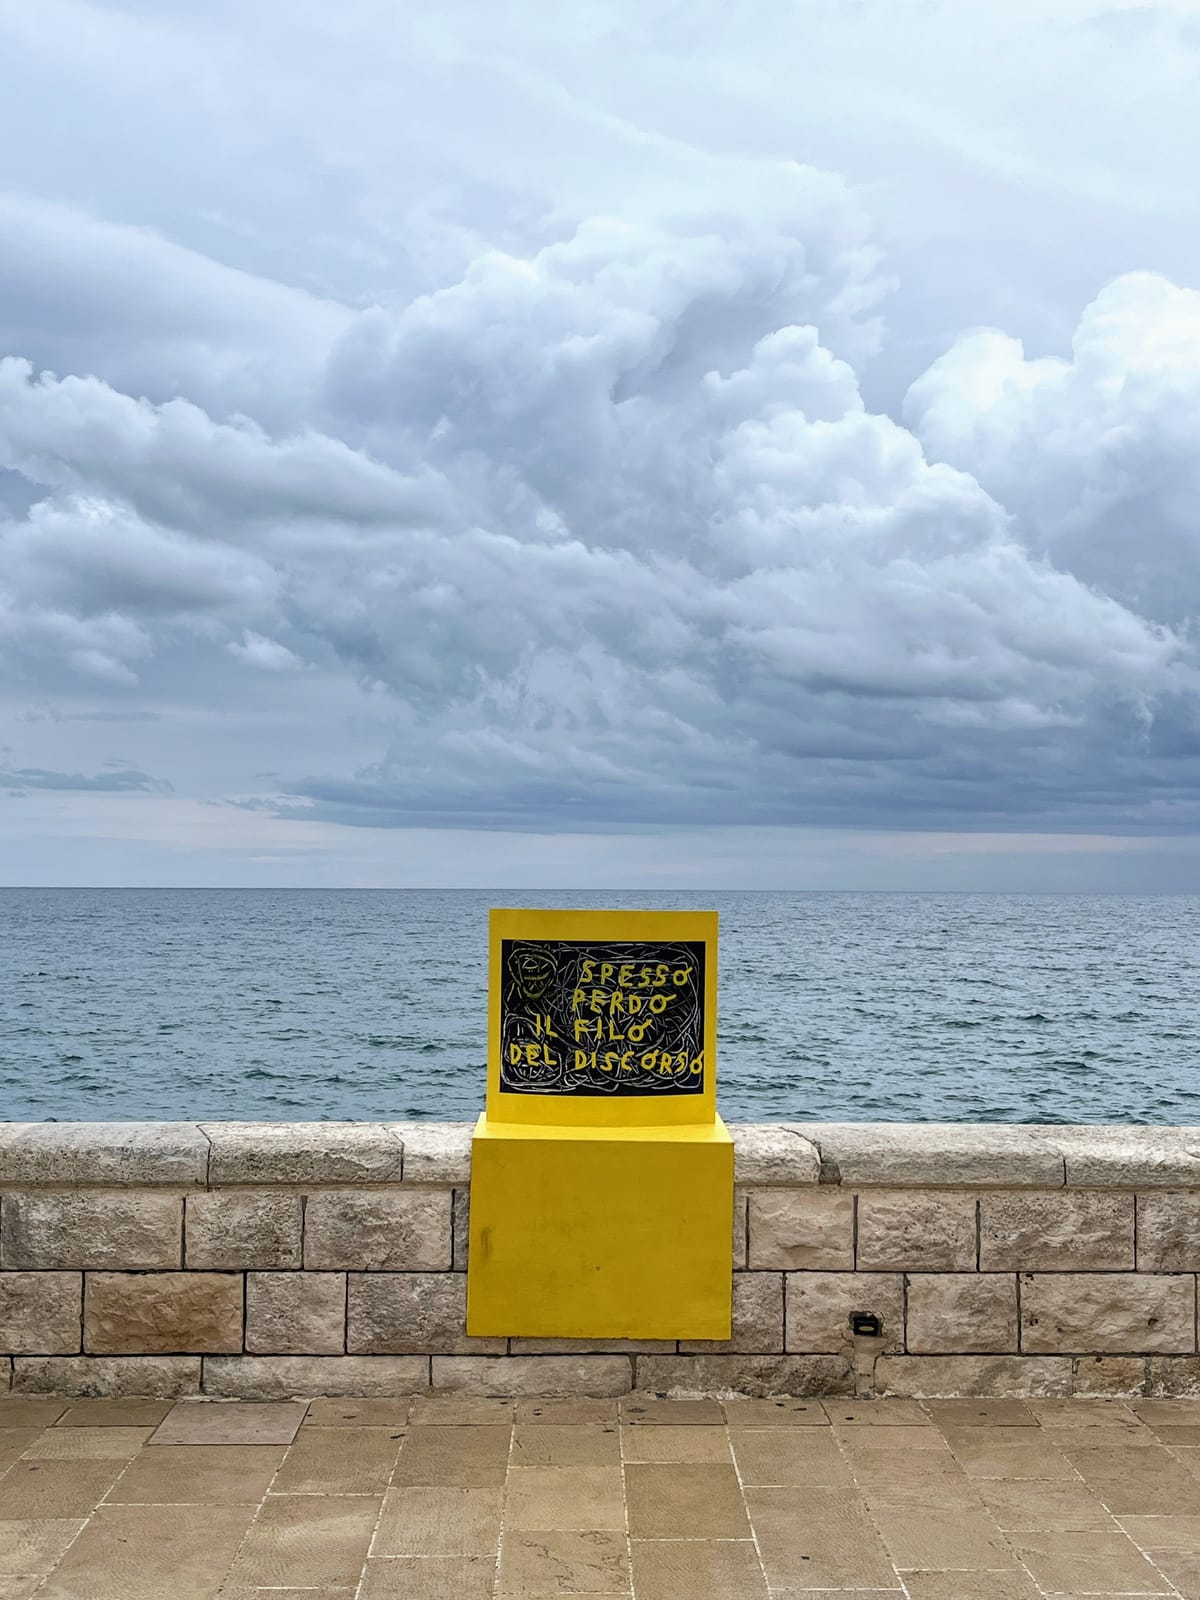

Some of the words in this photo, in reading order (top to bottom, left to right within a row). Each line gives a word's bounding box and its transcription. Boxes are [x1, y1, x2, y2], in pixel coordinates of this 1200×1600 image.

[579, 960, 693, 988] SPESSO
[572, 989, 677, 1014] PERDO
[535, 1014, 558, 1037] IL
[574, 1018, 653, 1042] FILO
[509, 1043, 557, 1067] DEL
[575, 1049, 704, 1075] DISCORSO
